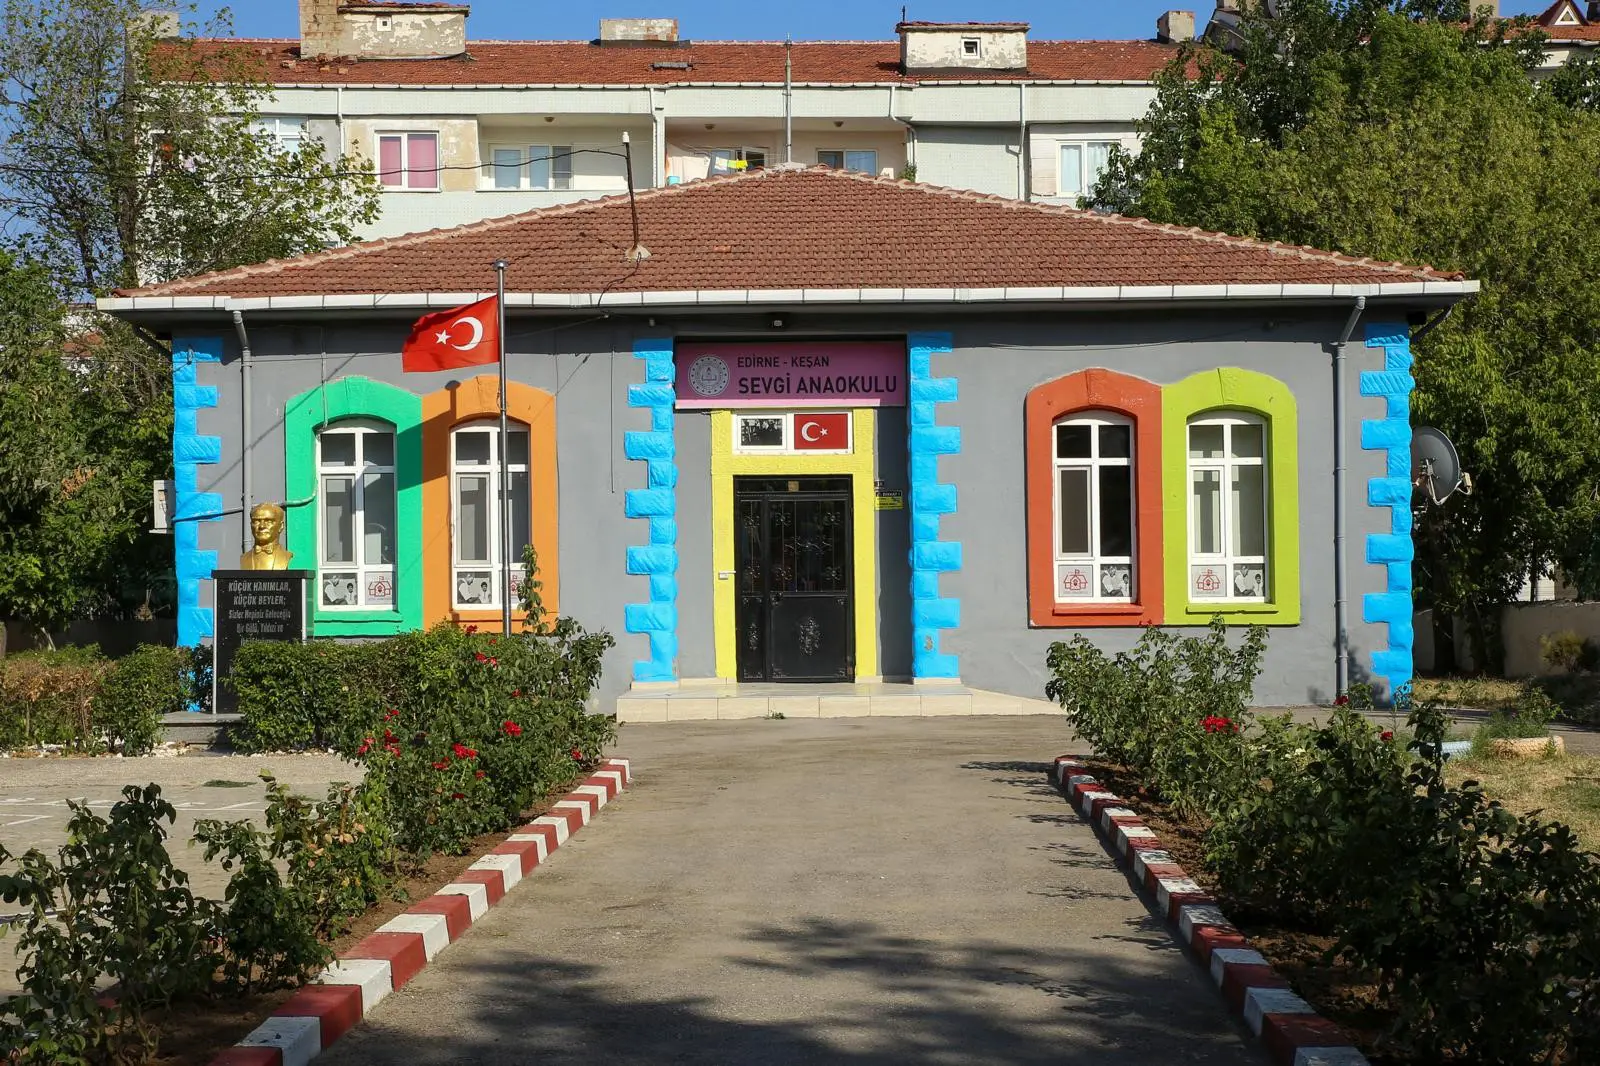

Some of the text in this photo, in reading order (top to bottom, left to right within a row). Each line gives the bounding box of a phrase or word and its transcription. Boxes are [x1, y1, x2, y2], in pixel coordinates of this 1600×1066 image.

[737, 354, 780, 368] EDİRNE
[791, 356, 830, 369] KEŞAN
[738, 373, 791, 394] SEVGİ
[796, 375, 897, 394] ANAOKULU
[228, 580, 252, 593] KÜÇÜK
[233, 594, 257, 607] KÜÇÜK
